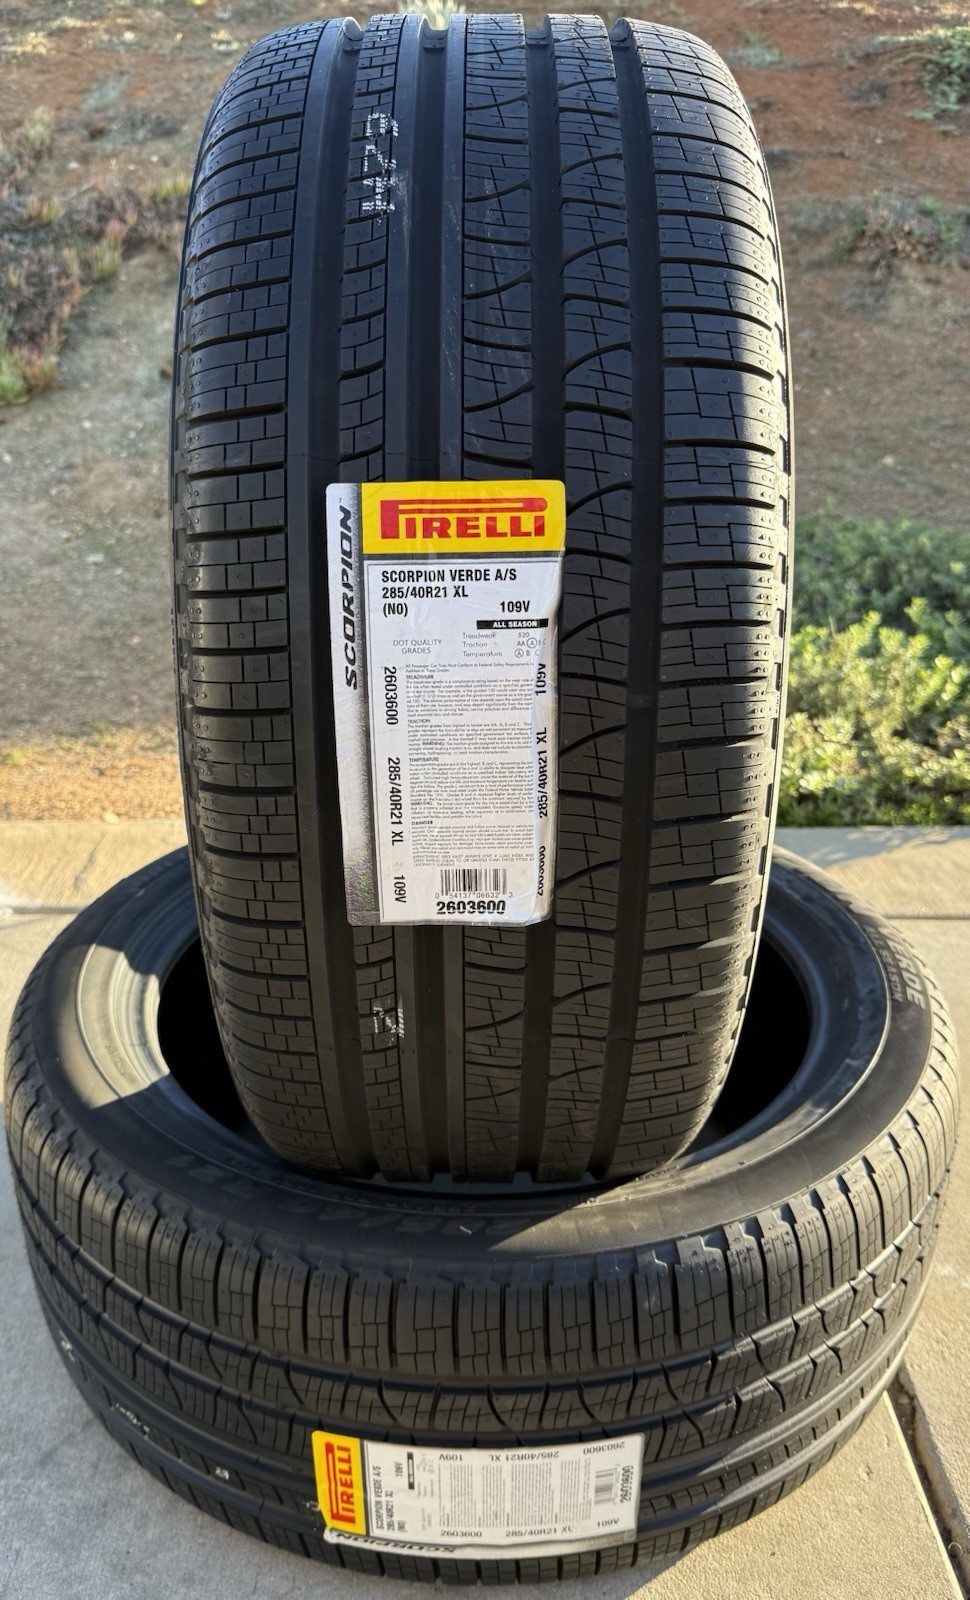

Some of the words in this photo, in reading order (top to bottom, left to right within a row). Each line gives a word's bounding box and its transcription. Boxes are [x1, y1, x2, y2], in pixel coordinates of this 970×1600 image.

[380, 497, 548, 539] PIRELLI
[382, 570, 445, 583] SCORPION
[450, 569, 491, 582] VERDE
[495, 568, 517, 581] A/S
[339, 505, 358, 690] SCORPION
[382, 586, 447, 599] 285/40R21
[453, 586, 469, 598] XL
[500, 600, 530, 613] 109V
[508, 620, 538, 628] SEASON
[411, 639, 442, 647] QUALITY
[463, 650, 502, 658] Temperature
[384, 666, 399, 725] 2603600
[536, 727, 547, 744] XL
[387, 757, 403, 825] 285/40R21
[537, 750, 548, 819] 285/40R21
[391, 831, 404, 846] XL
[393, 875, 407, 903] 109V
[436, 900, 506, 915] 2603600
[439, 1453, 463, 1461] 109V
[325, 1442, 356, 1524] PIRELLI
